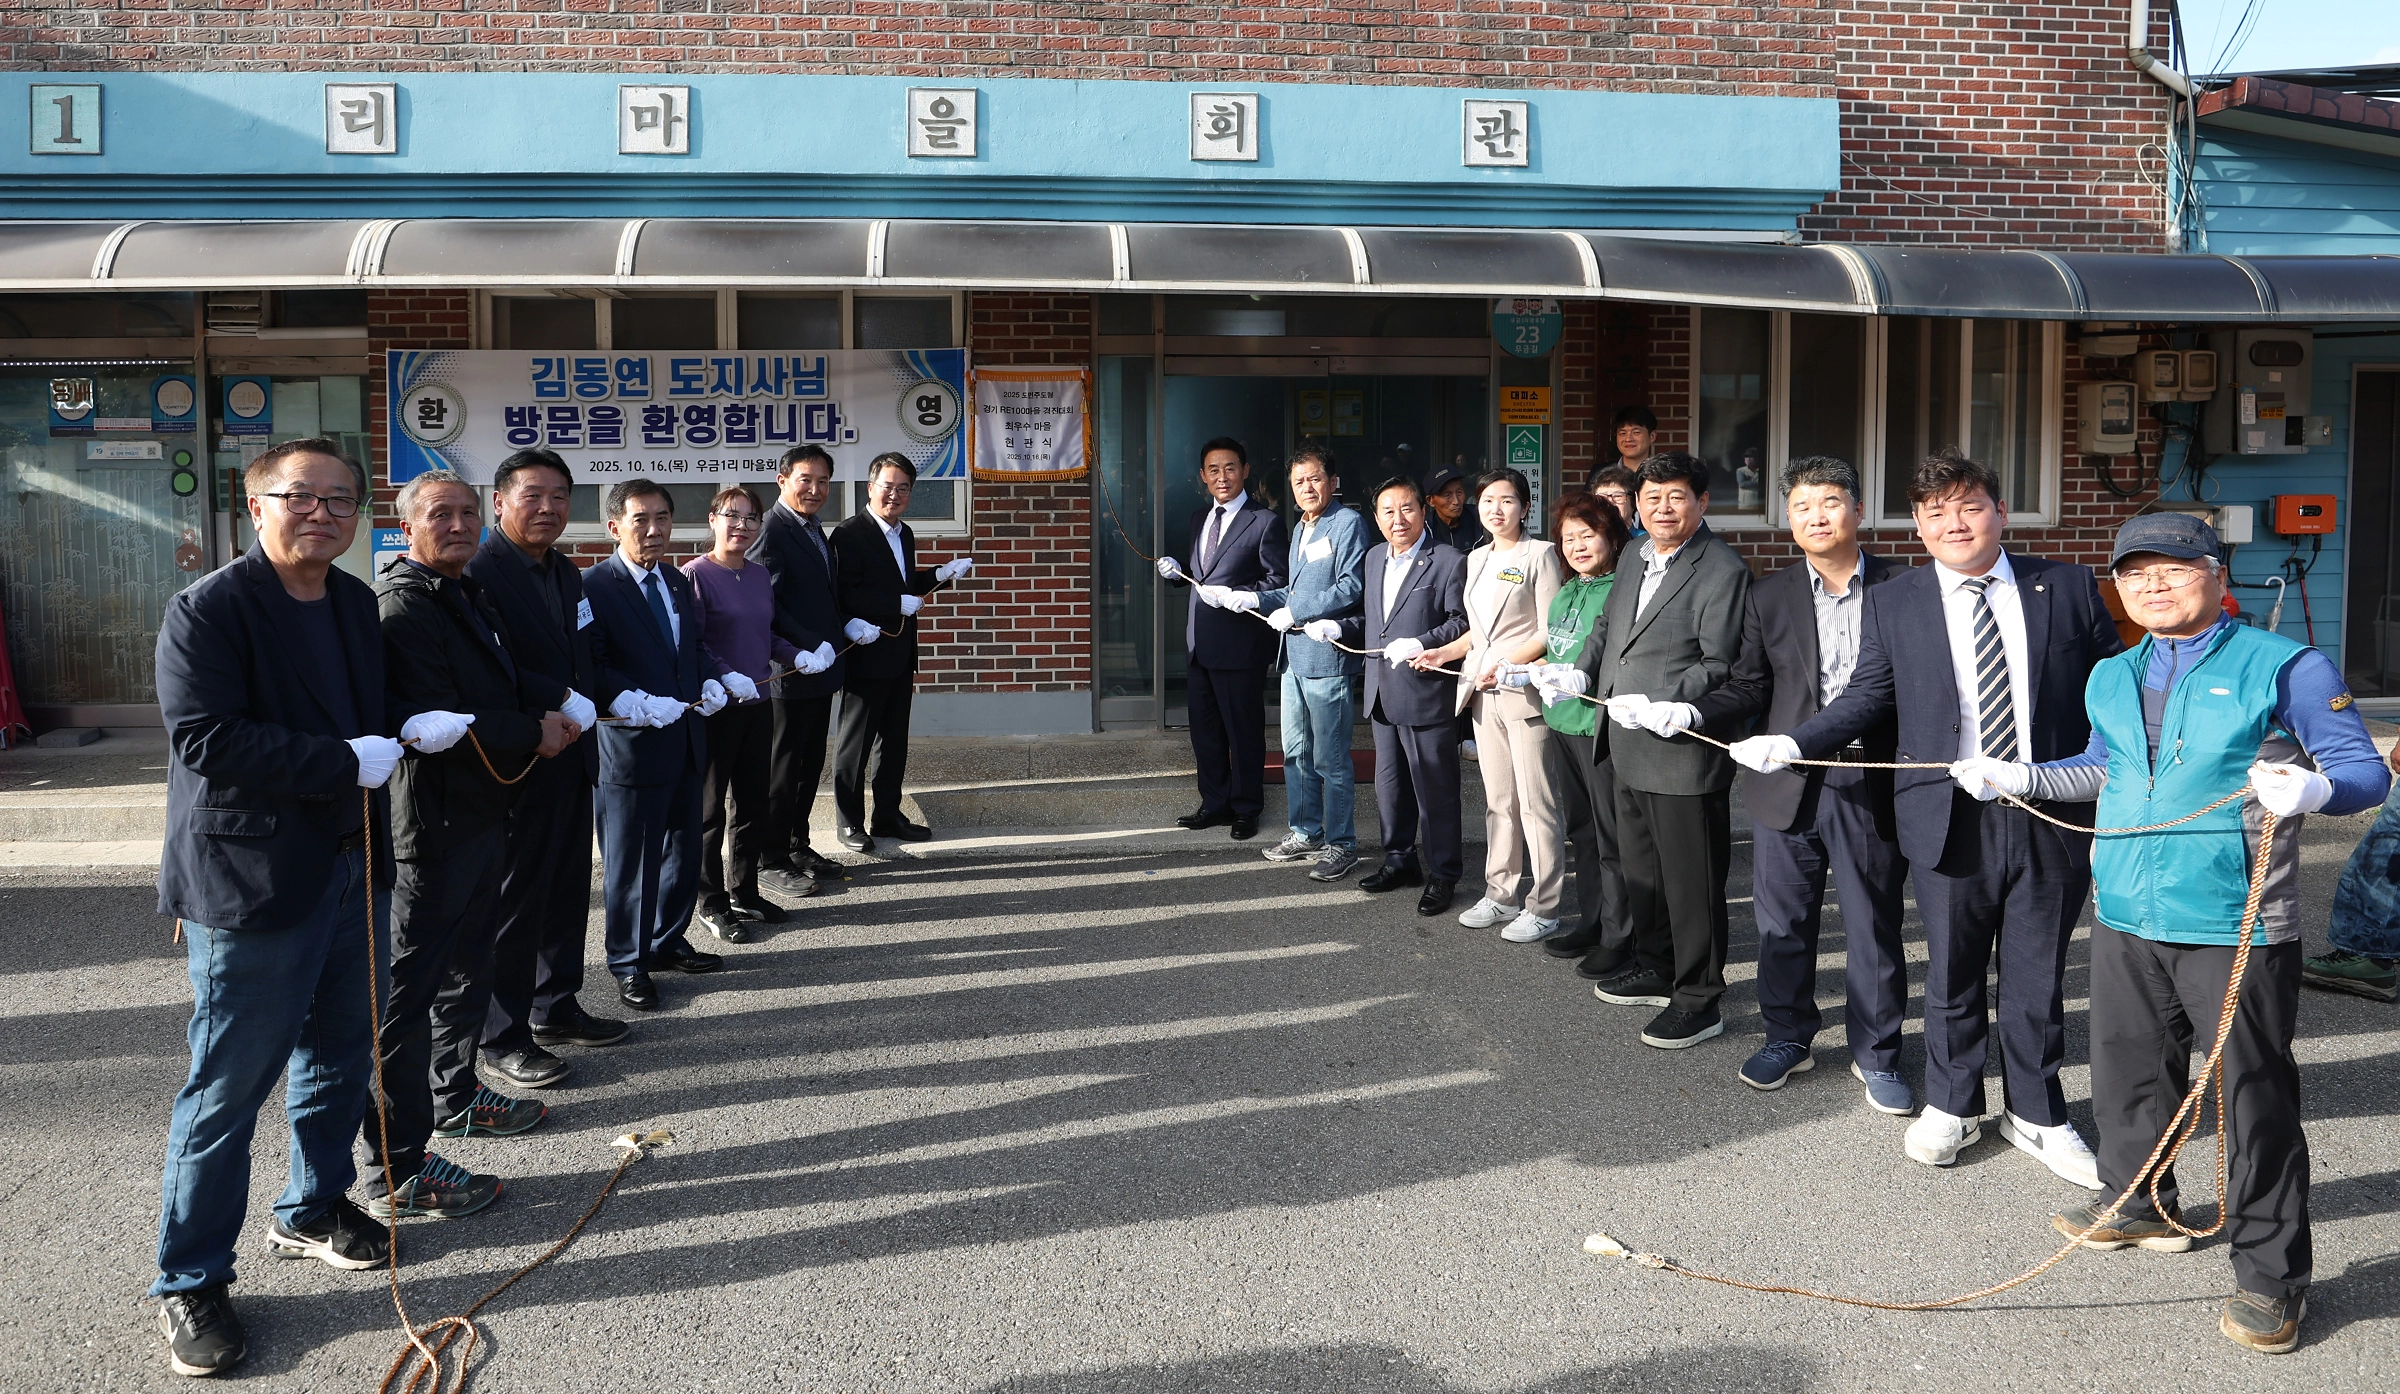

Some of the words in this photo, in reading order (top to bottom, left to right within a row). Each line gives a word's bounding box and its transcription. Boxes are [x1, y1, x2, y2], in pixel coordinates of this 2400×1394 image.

[53, 95, 83, 144] 1
[339, 92, 384, 146] 리
[629, 92, 683, 148] 마
[917, 96, 968, 149] 을
[1203, 101, 1245, 153] 회
[1473, 107, 1521, 158] 관
[1515, 325, 1540, 344] 23
[1514, 344, 1538, 354] 우금길
[530, 356, 650, 399] 김동연
[669, 355, 826, 398] 도지사님
[1021, 391, 1054, 399] 도민주도형
[1510, 390, 1539, 400] 대피소
[417, 397, 448, 430] 환
[915, 394, 942, 426] 영
[983, 405, 998, 414] 경기
[1000, 405, 1041, 415] RE100마을
[1043, 405, 1074, 415] 경진대회
[504, 404, 624, 446] 방문을
[640, 403, 856, 446] 환영합니다.
[1005, 421, 1031, 431] 최우수
[1034, 421, 1052, 431] 마을
[589, 460, 623, 472] 2025.
[627, 460, 645, 472] 10.
[650, 459, 688, 475] 16.(목)
[695, 459, 739, 472] 우금1리
[742, 458, 777, 472] 마을회
[1521, 469, 1539, 478] 더위
